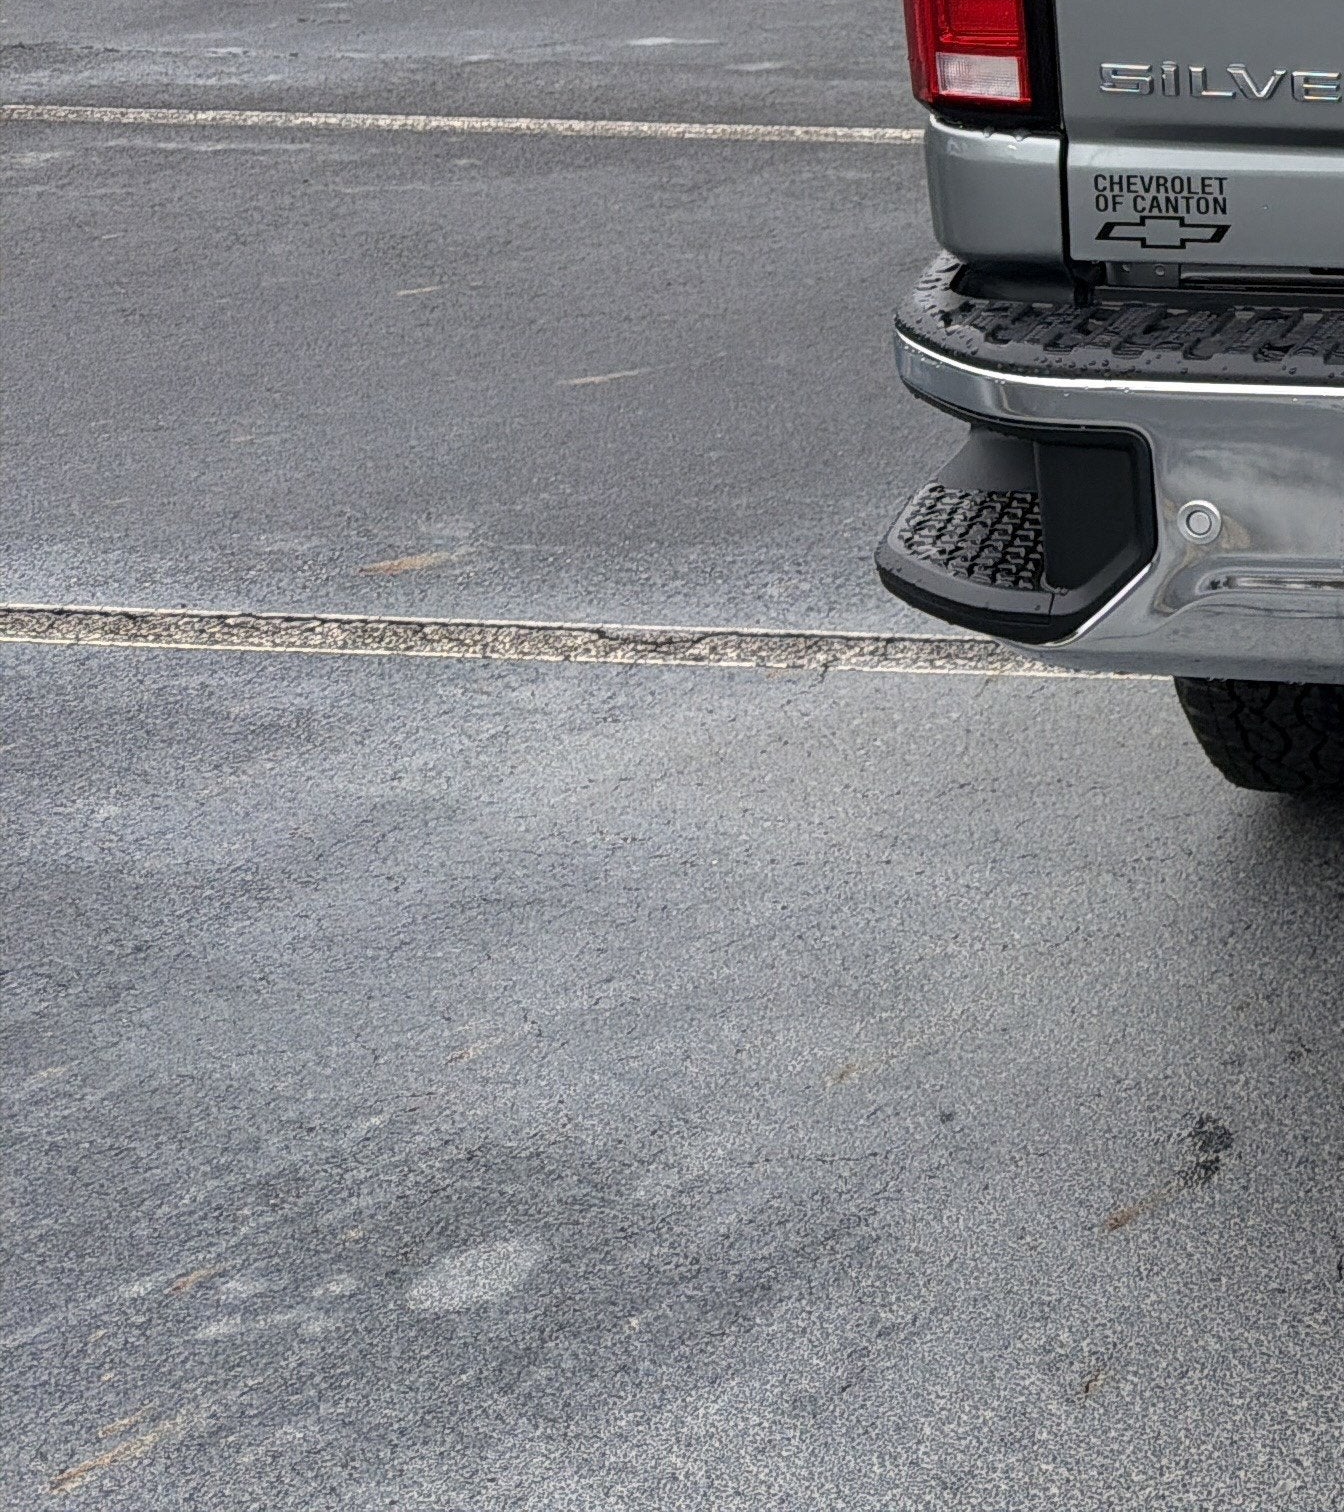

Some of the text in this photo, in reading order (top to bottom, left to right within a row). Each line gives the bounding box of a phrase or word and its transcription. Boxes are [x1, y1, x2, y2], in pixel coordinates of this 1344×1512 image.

[1093, 174, 1228, 195] CHEVROLET
[1095, 194, 1227, 215] OF CANTON
